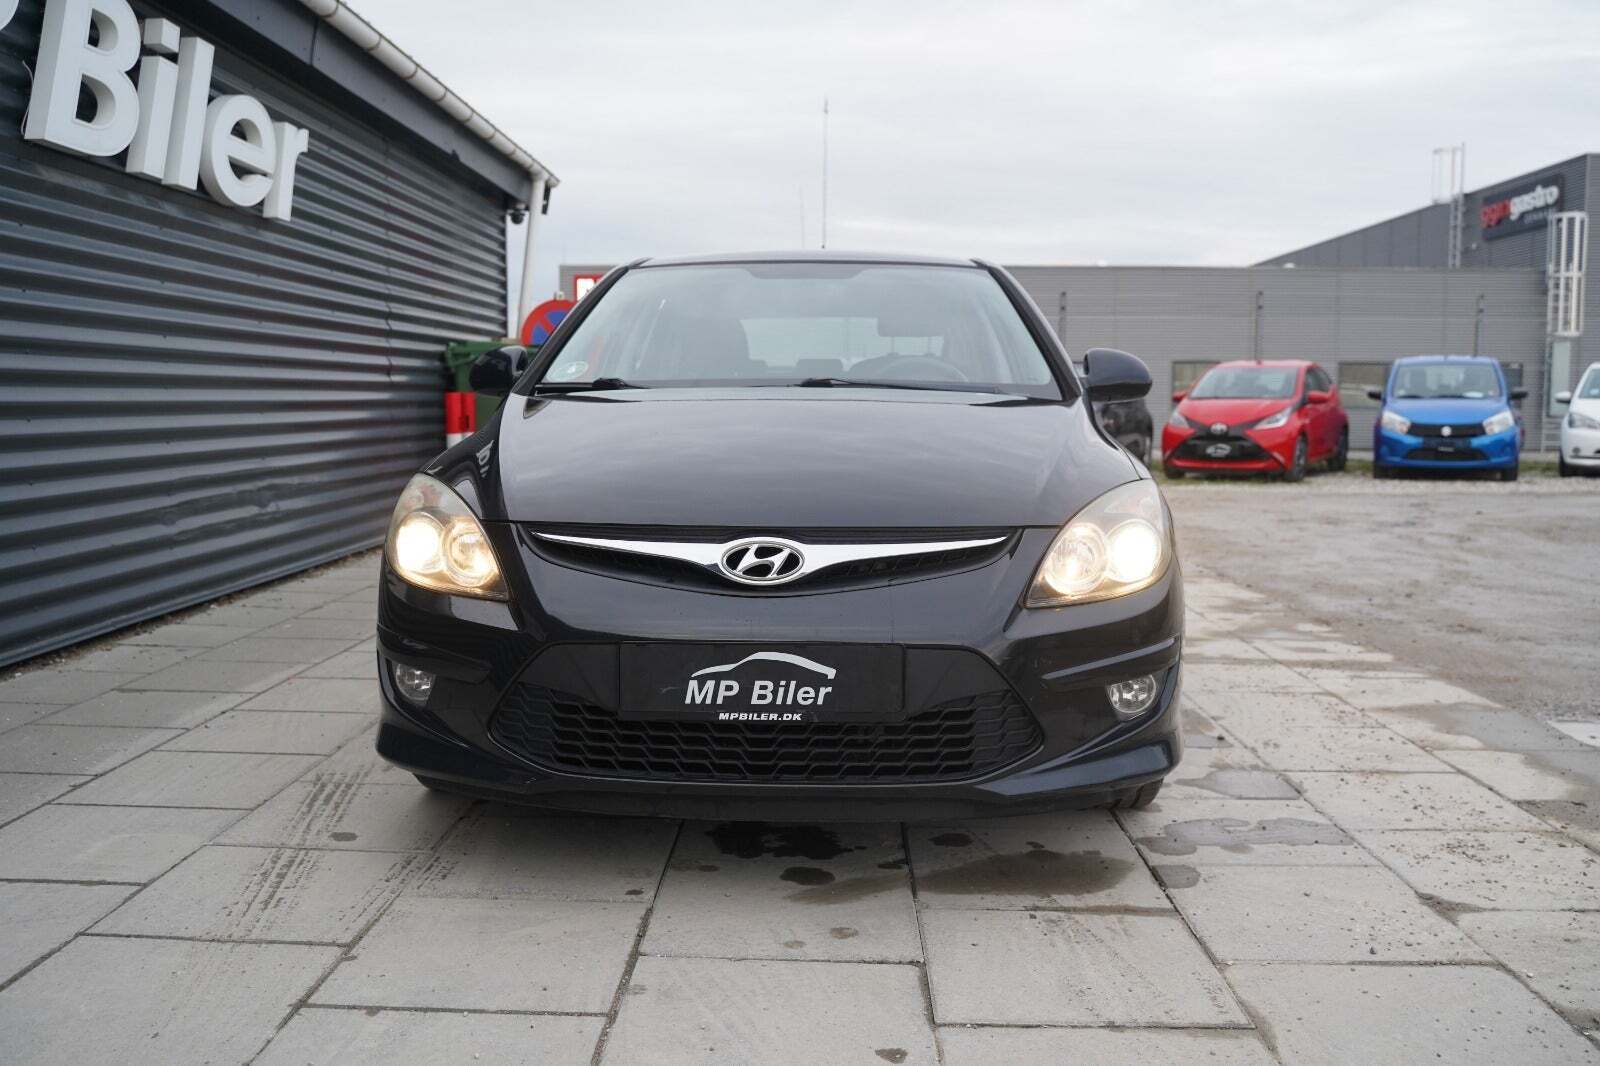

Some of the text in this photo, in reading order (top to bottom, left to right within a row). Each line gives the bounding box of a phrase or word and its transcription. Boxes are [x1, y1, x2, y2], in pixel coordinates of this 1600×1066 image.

[25, 0, 309, 221] Biler
[684, 679, 833, 705] MP Biler
[718, 712, 803, 721] MPBILER.DK
